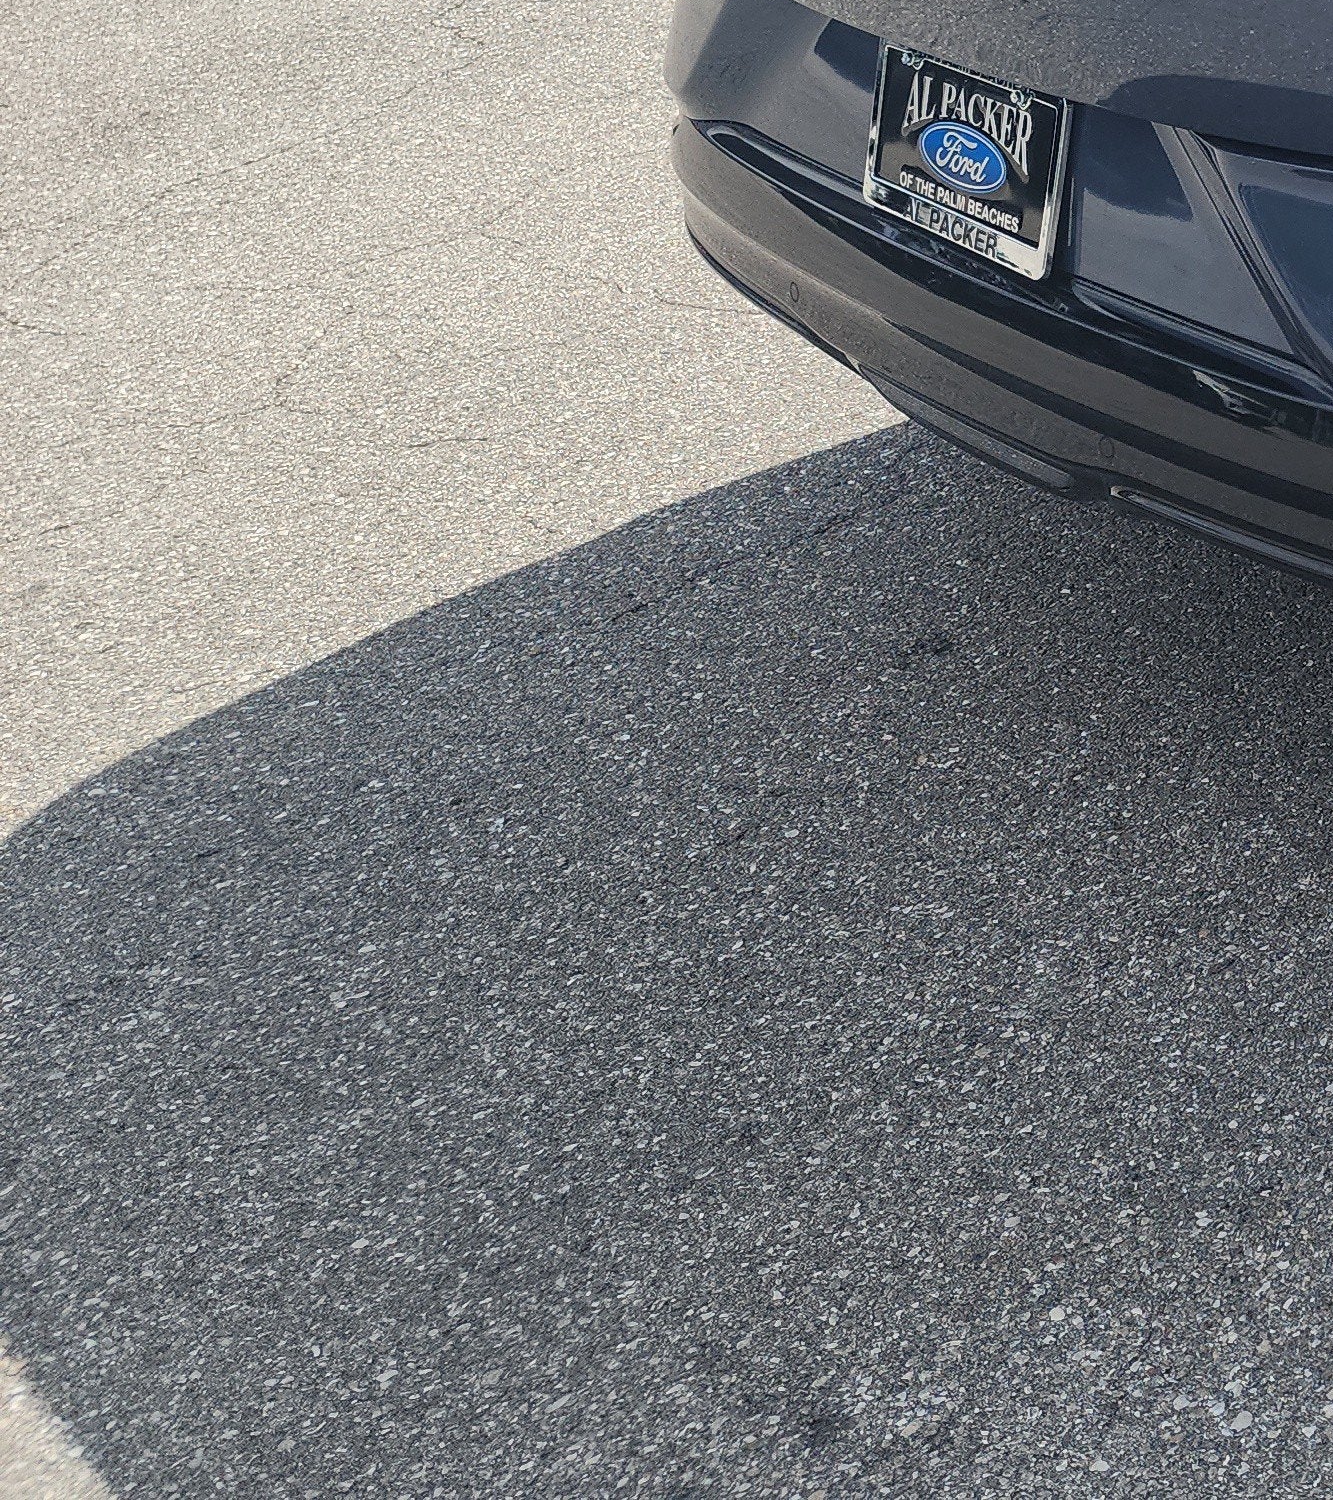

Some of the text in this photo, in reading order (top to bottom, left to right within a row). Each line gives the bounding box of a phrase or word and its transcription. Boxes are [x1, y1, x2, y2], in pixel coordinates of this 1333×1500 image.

[902, 71, 1032, 176] AL PACKER
[935, 131, 990, 183] Ford
[899, 171, 1020, 234] OF THE PALM BEACHES
[929, 207, 998, 259] PACKER
